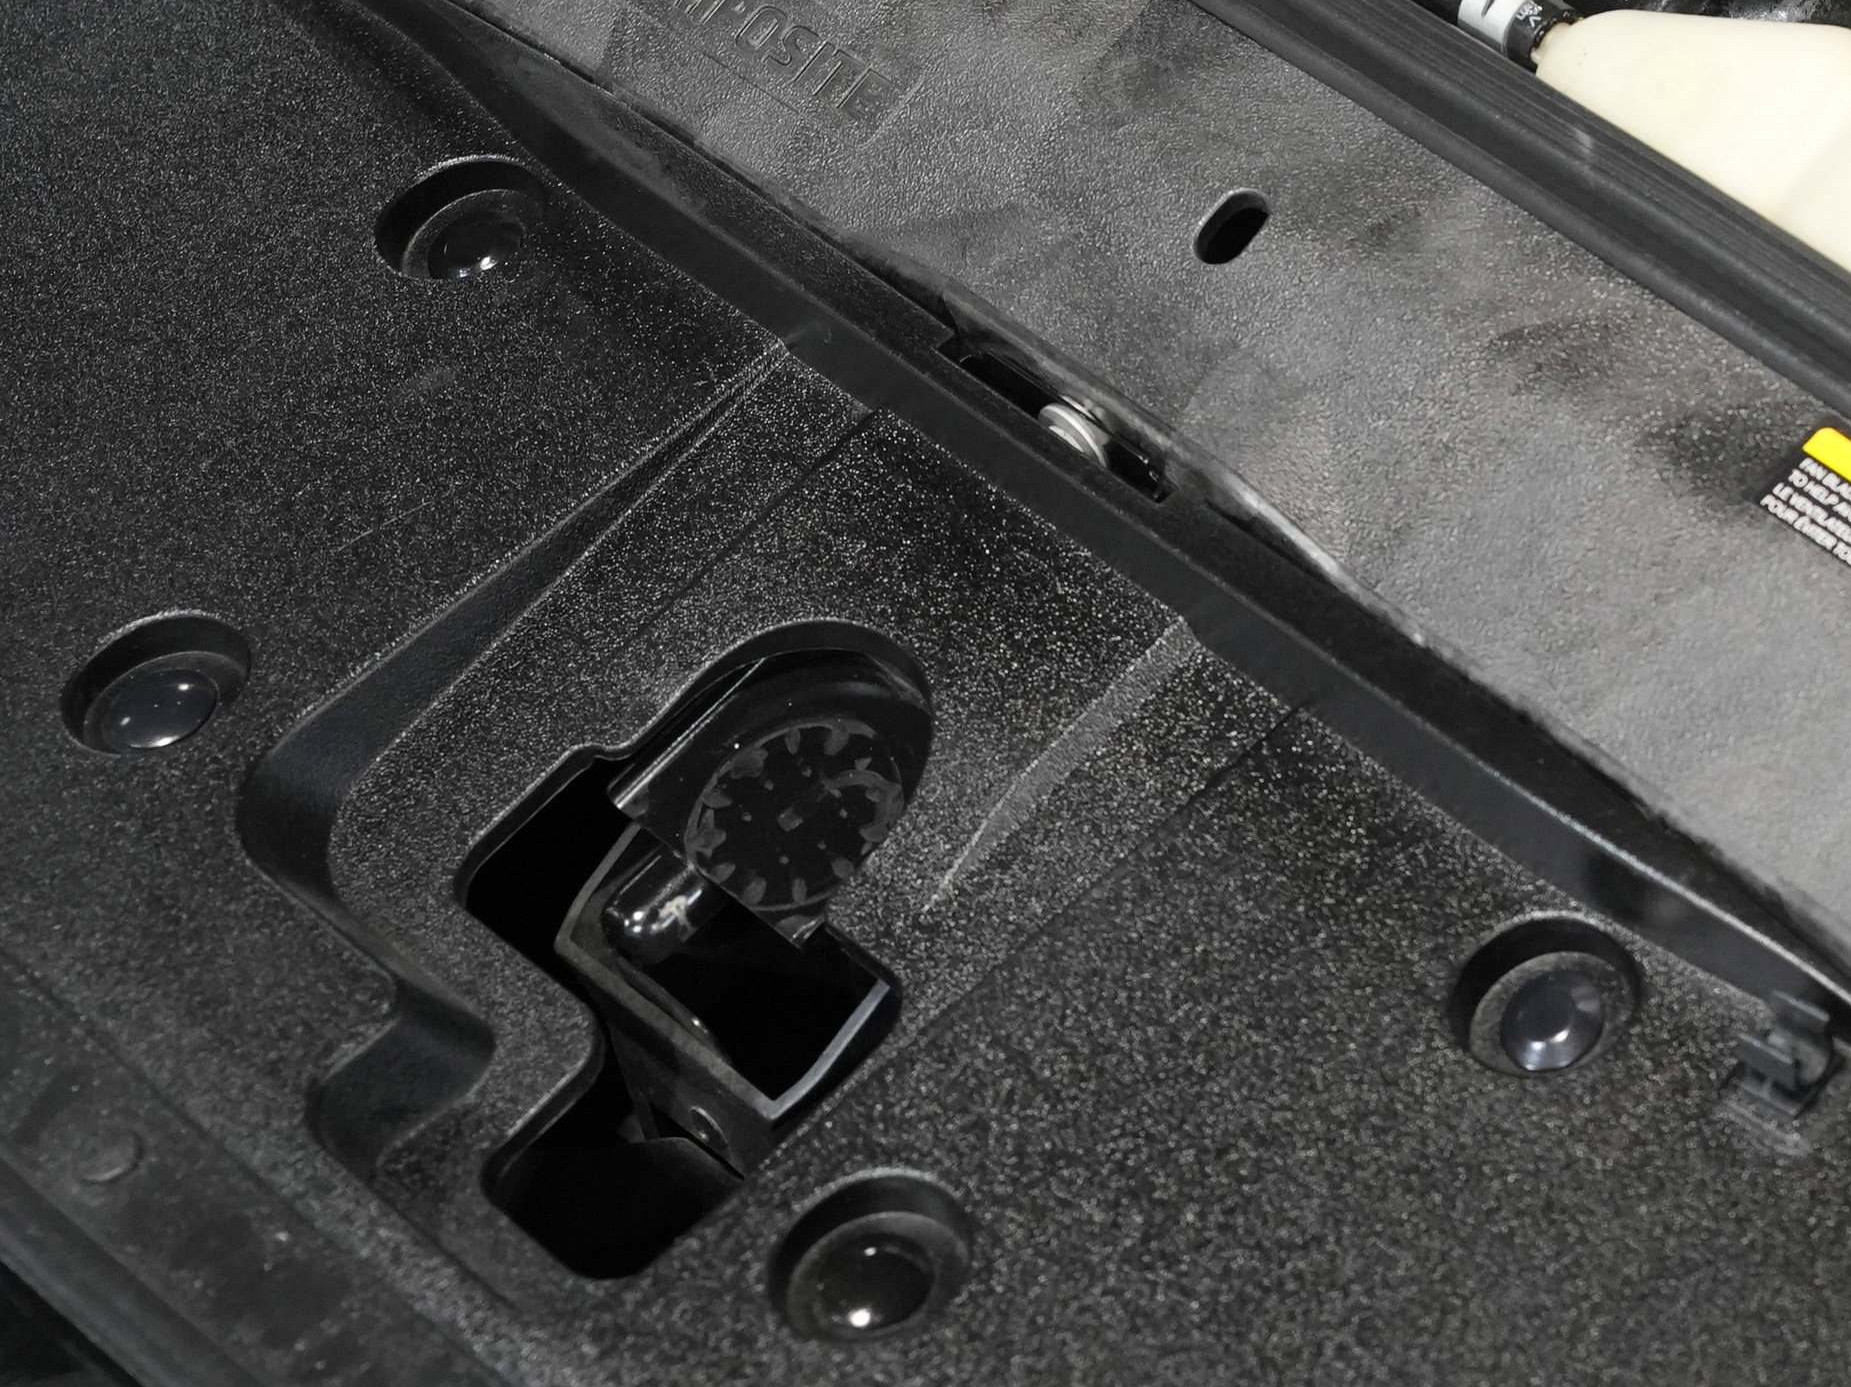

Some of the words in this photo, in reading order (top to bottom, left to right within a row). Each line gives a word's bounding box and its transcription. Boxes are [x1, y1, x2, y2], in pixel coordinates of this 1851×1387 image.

[1799, 457, 1827, 479] FAN
[1772, 482, 1792, 499] LE
[1787, 469, 1809, 488] TO
[1803, 480, 1838, 508] HELP
[1760, 494, 1799, 524] POUR
